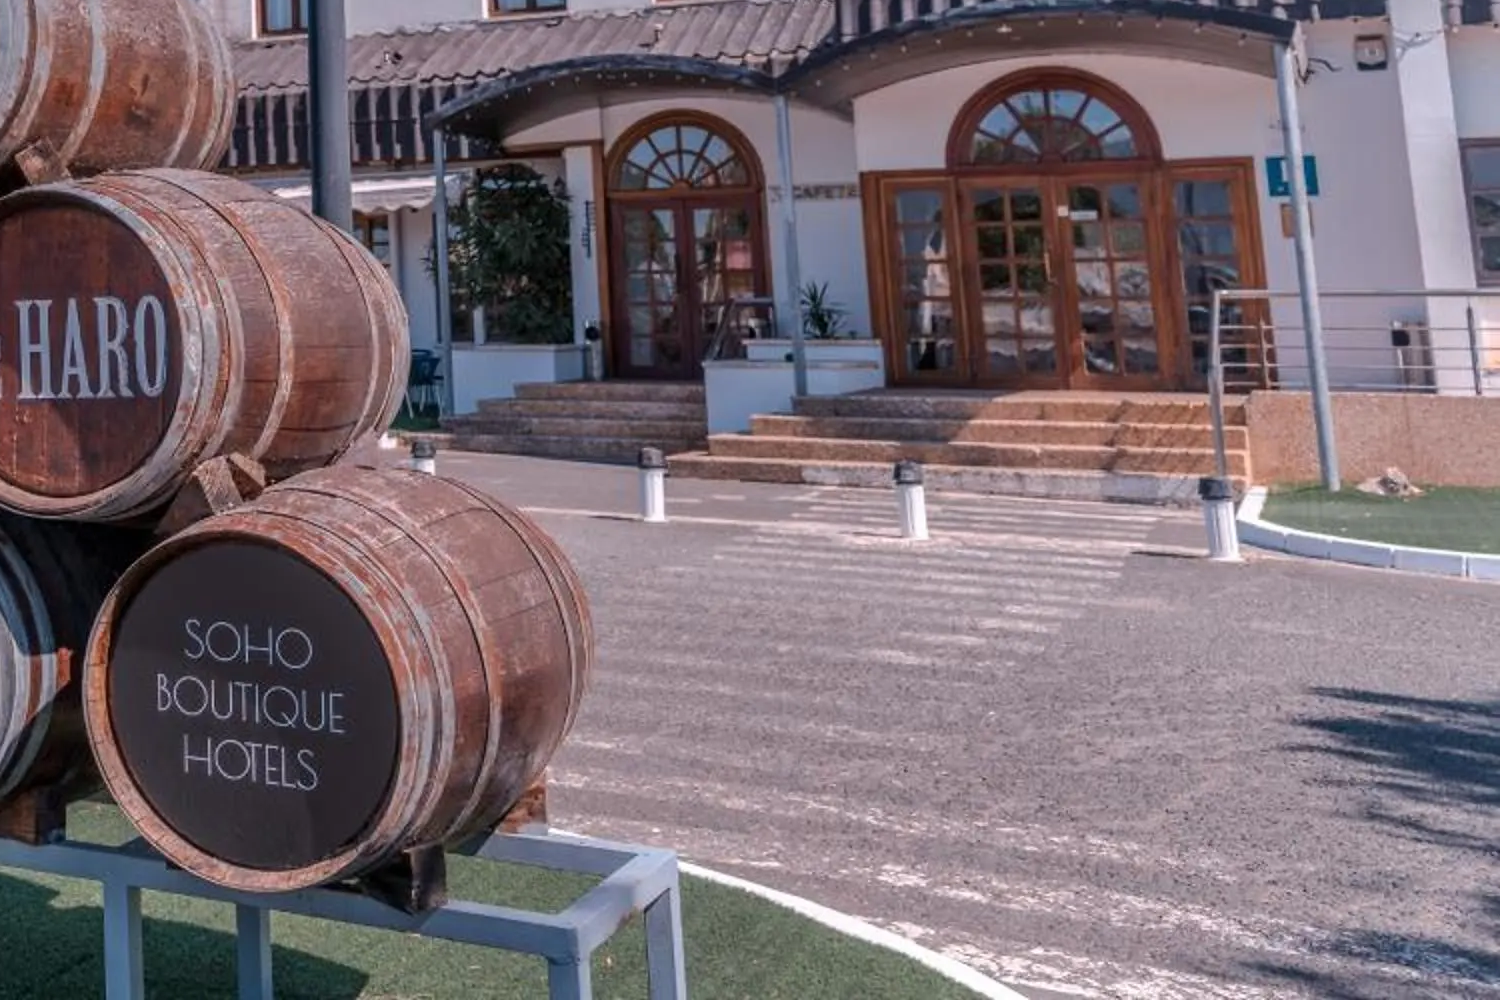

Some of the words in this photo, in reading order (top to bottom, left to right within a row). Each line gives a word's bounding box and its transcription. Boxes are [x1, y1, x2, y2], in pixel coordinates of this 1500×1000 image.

[15, 295, 168, 399] HARO
[183, 618, 314, 670] SOHO
[156, 672, 346, 735] BOUTIQUE
[183, 734, 319, 793] HOTELS
